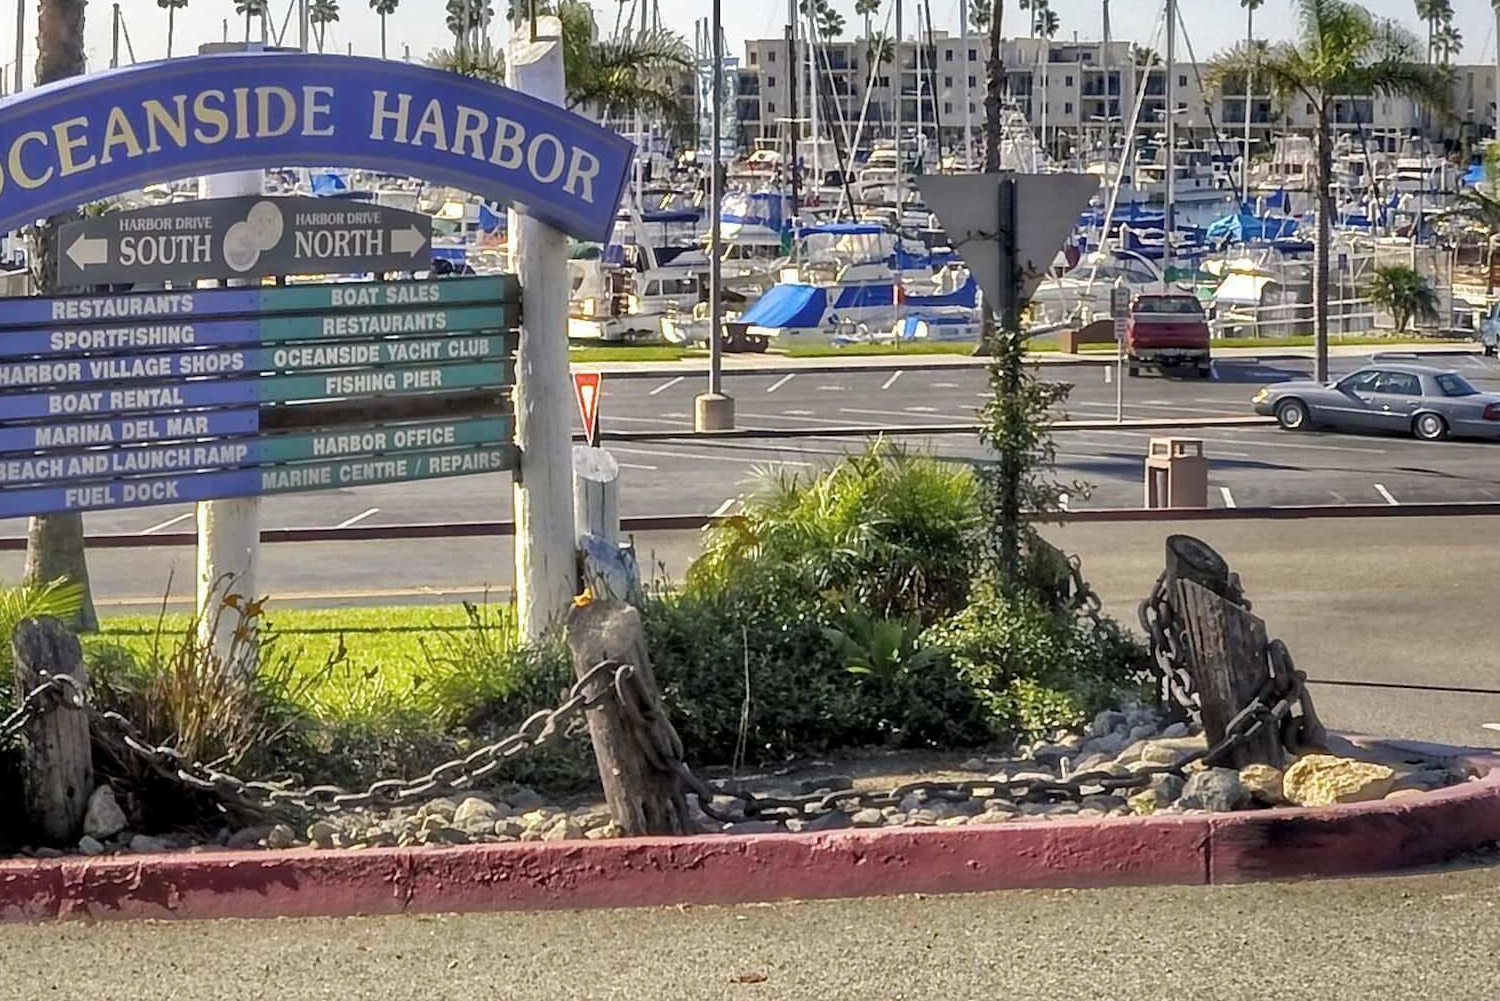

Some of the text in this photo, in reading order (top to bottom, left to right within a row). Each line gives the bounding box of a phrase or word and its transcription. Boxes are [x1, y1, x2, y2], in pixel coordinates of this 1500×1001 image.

[371, 90, 601, 203] HARBOR
[119, 216, 212, 231] HARBOR DRIVE
[295, 211, 381, 226] HARBOR DRIVE
[119, 234, 212, 265] SOUTH
[294, 229, 383, 259] NORTH
[52, 294, 193, 320] RESTAURANTS
[331, 285, 440, 306] BOAT SALES
[323, 312, 447, 336] RESTAURANTS
[50, 326, 195, 351] SPORTFISHING
[90, 357, 171, 379] VILLAGE
[179, 353, 244, 375] SHOPS
[274, 339, 490, 367] OCEANSIDE YACHT CLUB
[326, 370, 442, 395] FISHING PIER
[49, 388, 184, 414] BOAT RENTAL
[35, 416, 208, 447] MARINA DEL MAR
[313, 427, 455, 455] HARBOR OFFICE
[67, 455, 108, 475] AND
[112, 449, 190, 472] LAUNCH
[194, 444, 248, 466] RAMP
[261, 467, 331, 490] MARINE
[339, 460, 407, 482] CENTRE
[428, 452, 501, 472] REPAIRS
[65, 481, 179, 507] FUEL DOCK
